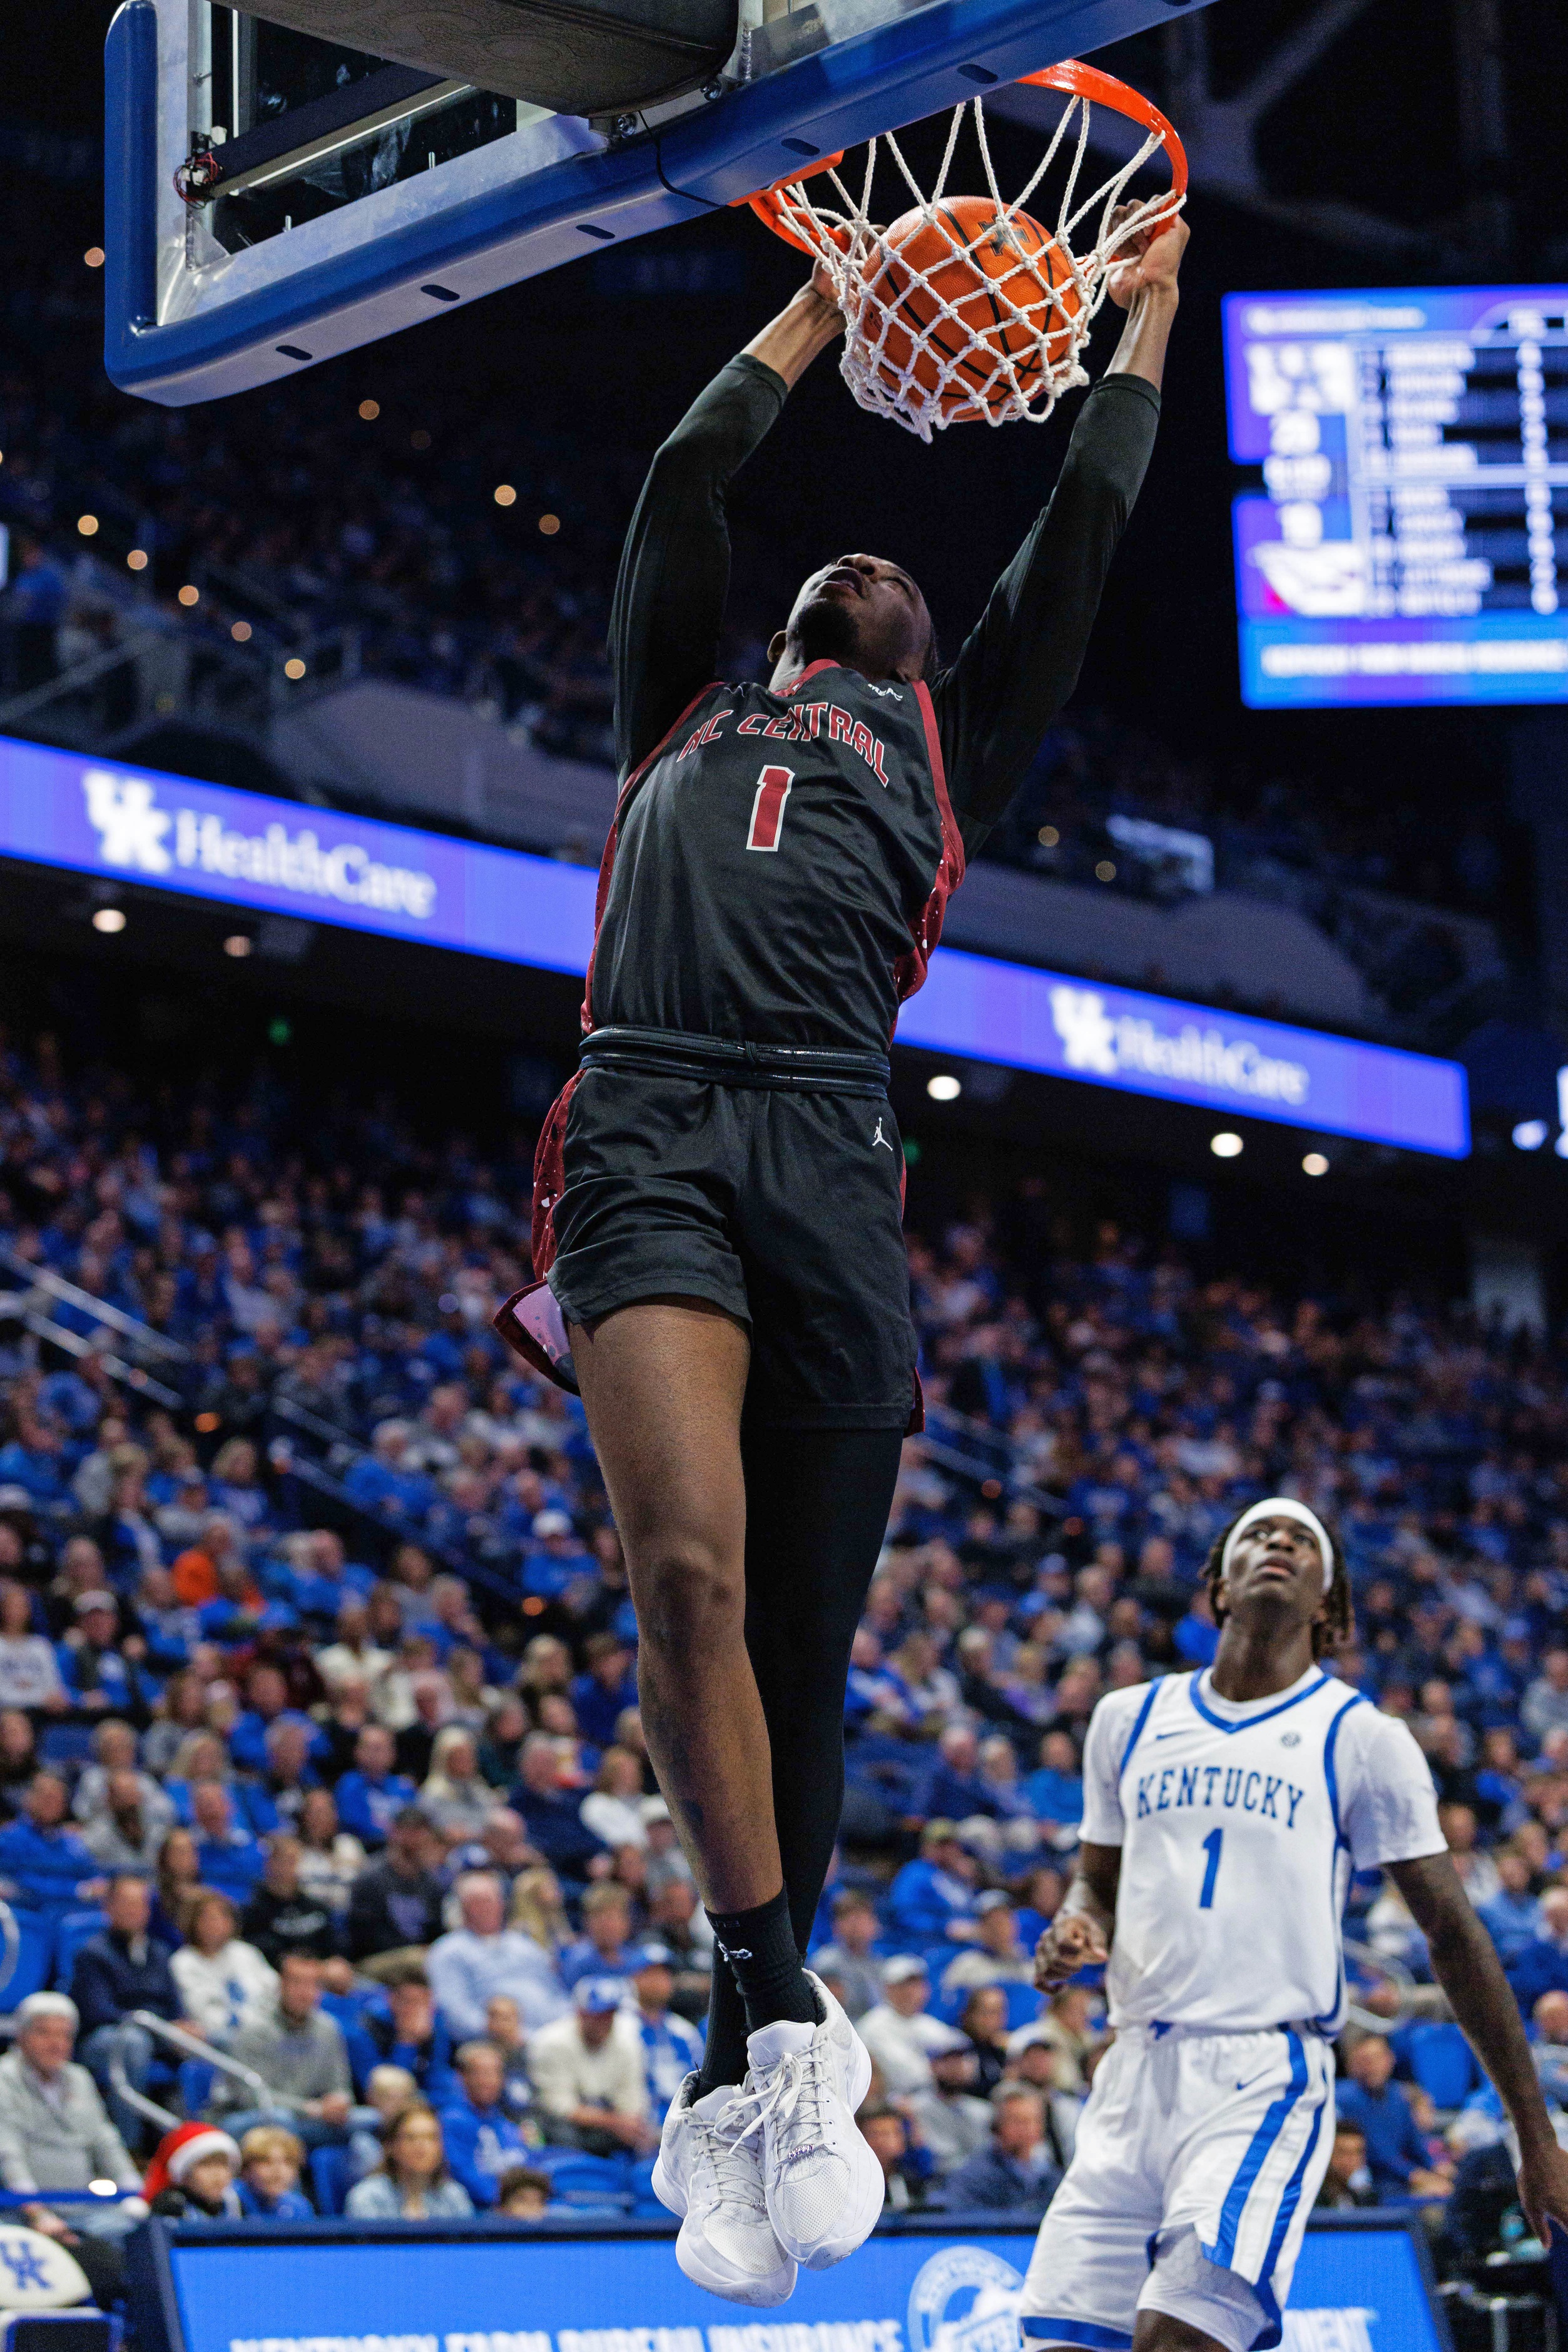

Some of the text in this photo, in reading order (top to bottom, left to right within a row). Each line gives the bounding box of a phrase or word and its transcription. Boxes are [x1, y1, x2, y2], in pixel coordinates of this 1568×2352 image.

[676, 702, 889, 788] NC CENTRAL
[83, 769, 437, 919] UK HealthCare
[746, 764, 795, 852] 1
[1136, 1766, 1304, 1829] KENTUCKY
[1199, 1828, 1223, 1909] 1
